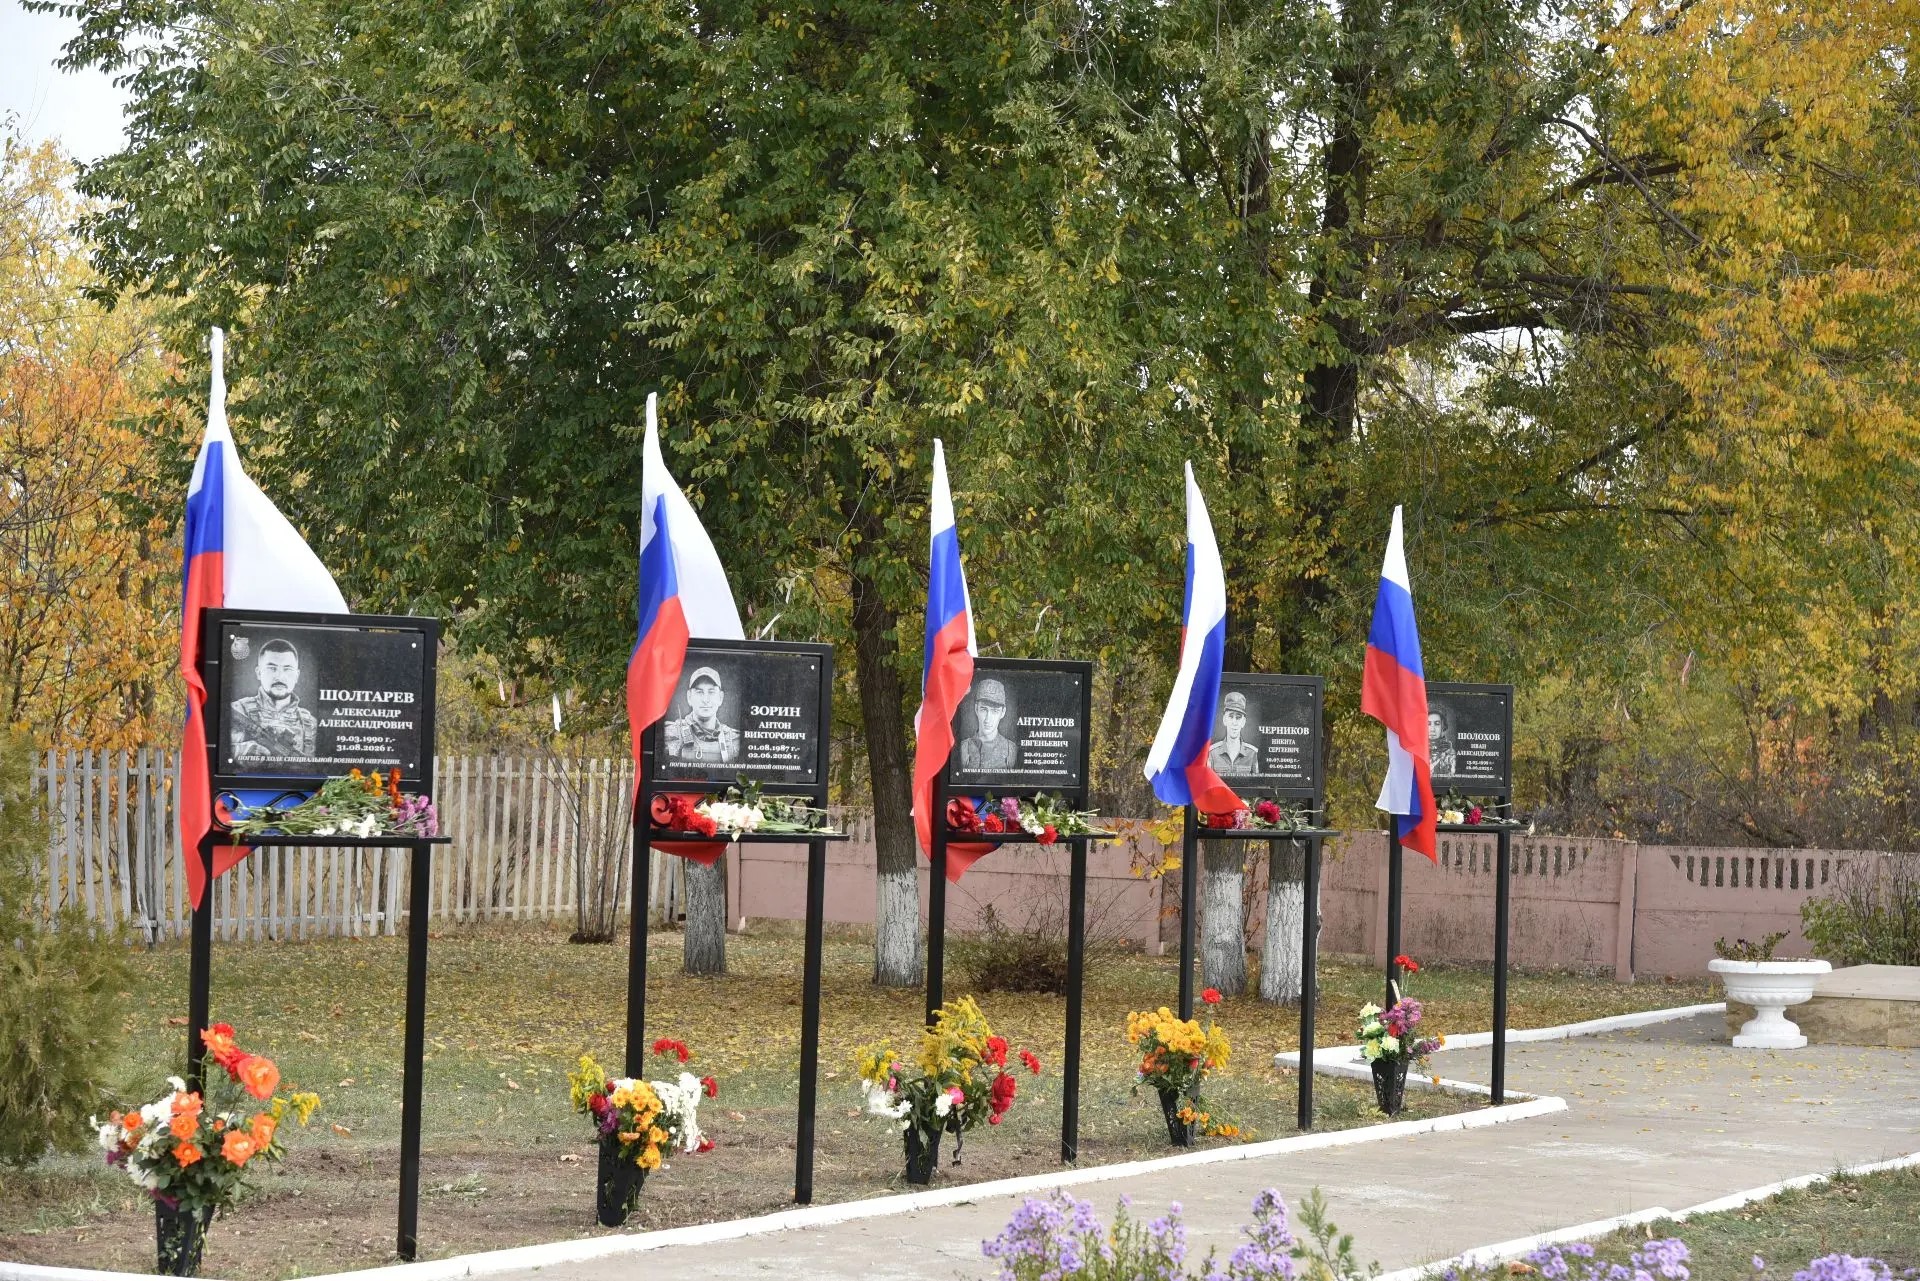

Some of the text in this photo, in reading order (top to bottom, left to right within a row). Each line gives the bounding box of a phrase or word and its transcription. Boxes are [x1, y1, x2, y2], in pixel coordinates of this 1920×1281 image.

[319, 689, 415, 704] ШОЛТАРЕВ
[332, 708, 402, 718] АЛЕКСАНДР
[750, 706, 801, 717] ЗОРИН
[318, 718, 413, 730] АЛЕКСАНДРОВИЧ
[758, 721, 792, 730] АНТОН
[1016, 716, 1075, 727] АНТУГАНОВ
[744, 730, 806, 740] ВИКТОРОВИЧ
[1028, 730, 1063, 738] ДАНИИЛ
[1258, 726, 1310, 735] ЧЕРНИКОВ
[336, 735, 384, 744] 19.03.1990
[1457, 732, 1501, 741] ШОЛОХОВ
[284, 756, 332, 764] СПЕЦИАЛЬНОЙ
